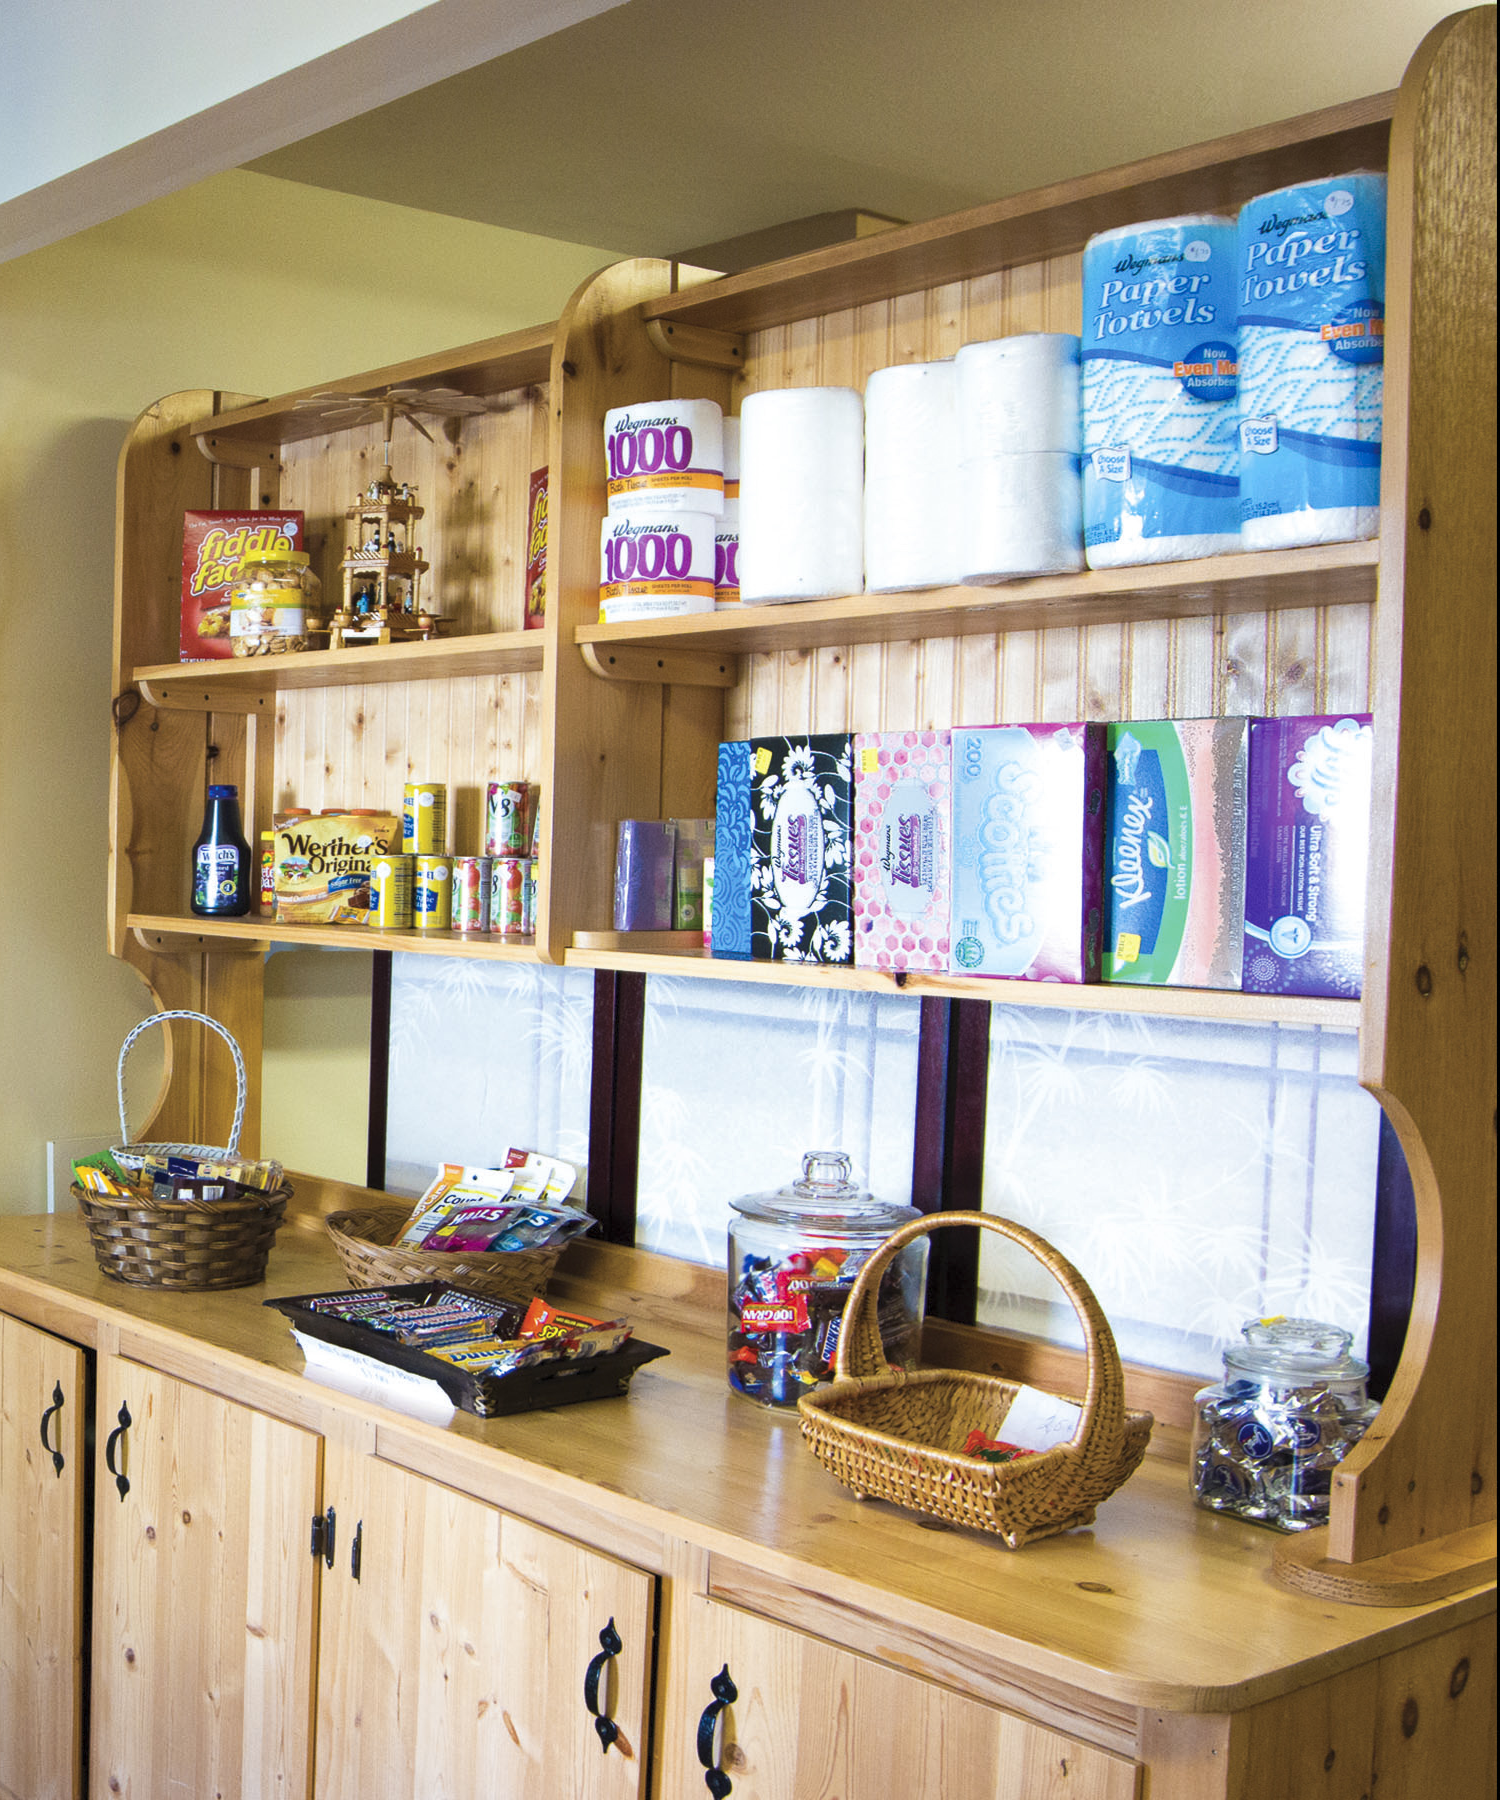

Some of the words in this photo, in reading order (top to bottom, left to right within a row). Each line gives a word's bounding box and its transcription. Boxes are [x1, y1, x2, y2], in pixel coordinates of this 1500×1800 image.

[1113, 254, 1185, 276] Wegmans
[1245, 229, 1361, 274] Paper
[1099, 274, 1211, 309] Paper
[1241, 253, 1367, 307] Towels
[1093, 299, 1216, 341] Towels
[1353, 308, 1379, 318] Now
[1321, 322, 1364, 341] Even
[1174, 362, 1213, 376] Even
[1204, 349, 1227, 358] Now
[615, 414, 678, 437] Wegmans
[608, 426, 692, 479] 1000
[200, 528, 291, 563] fiddle
[613, 519, 679, 542] Wegmans
[605, 533, 692, 581] 1000
[966, 736, 982, 778] 200
[281, 833, 388, 857] Werther's
[772, 824, 785, 868] Wegmans
[781, 813, 799, 882] Tissues
[881, 824, 894, 872] Wegmans
[891, 813, 911, 887] Tissues
[1111, 794, 1153, 909] Kleenex
[1310, 825, 1322, 852] Ultra
[202, 850, 235, 861] Wch's
[1309, 852, 1321, 875] Soft
[1173, 863, 1187, 900] lotion
[1309, 876, 1320, 885] &
[1305, 885, 1320, 922] Strong
[1116, 933, 1126, 957] PRICE
[449, 1208, 504, 1226] HALLS
[774, 1310, 794, 1320] 100
